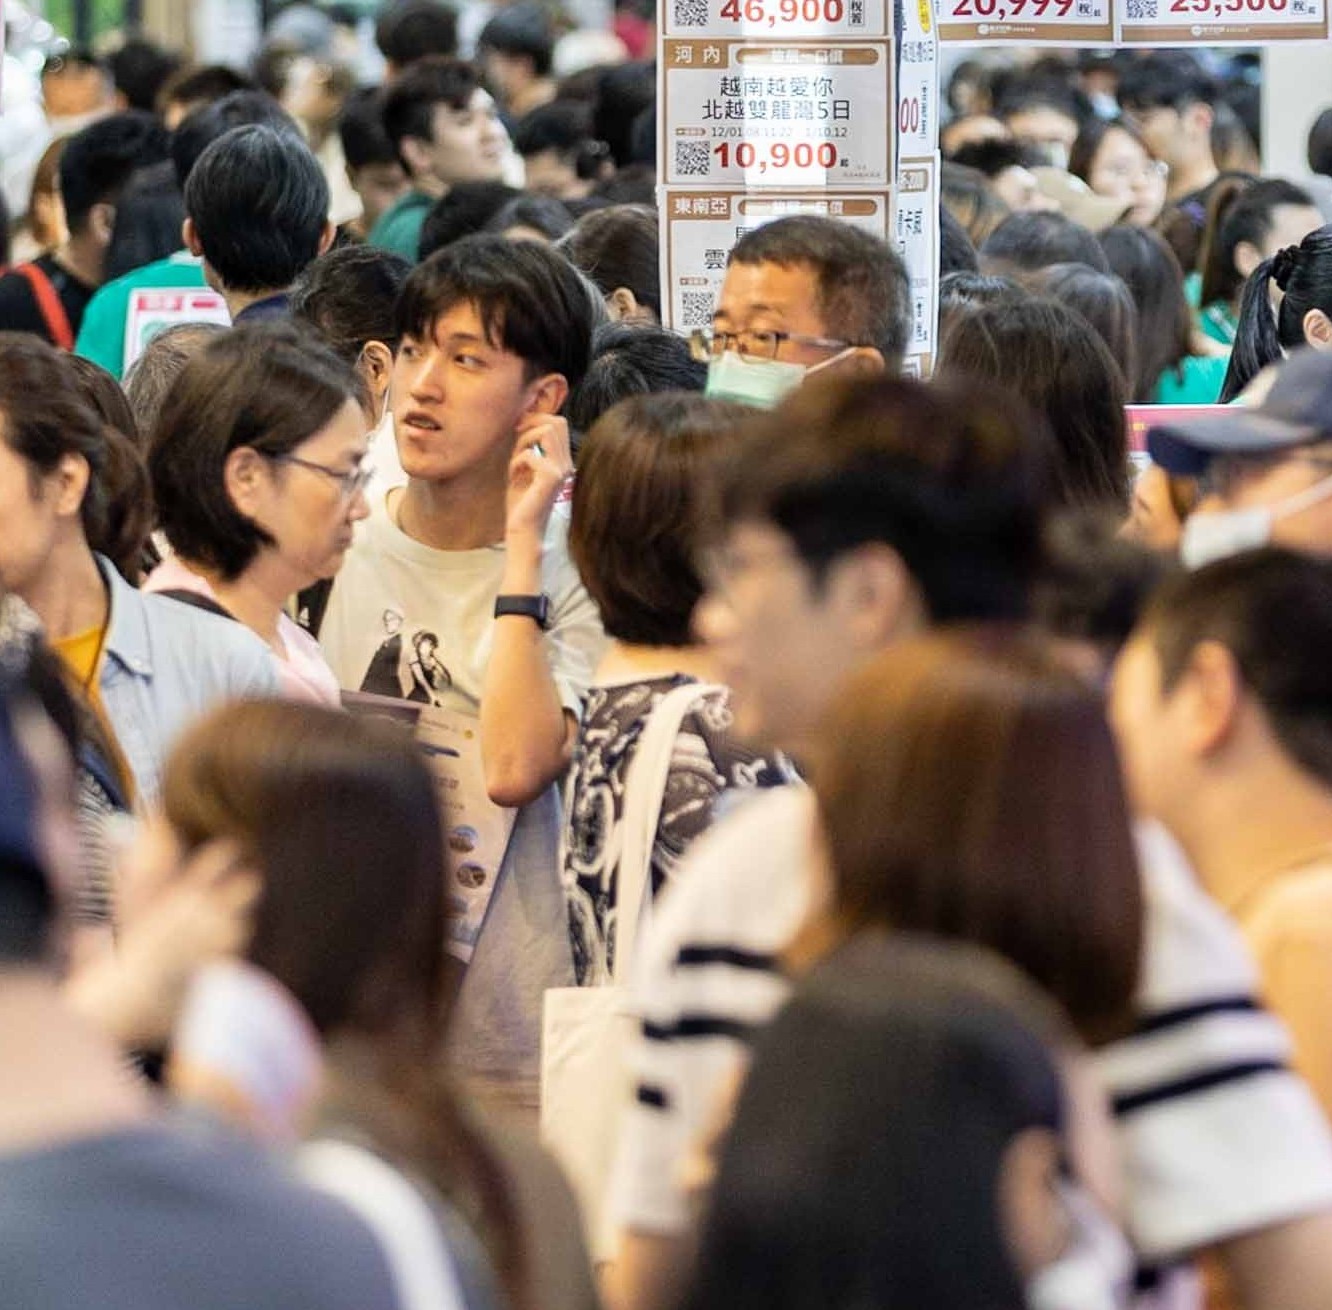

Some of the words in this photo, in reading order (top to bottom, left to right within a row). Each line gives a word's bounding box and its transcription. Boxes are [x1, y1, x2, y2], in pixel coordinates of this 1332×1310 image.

[720, 0, 843, 27] 46,900
[952, 0, 1073, 20] 20,999
[674, 46, 721, 64] 河內
[720, 76, 833, 97] 越南越愛你
[702, 99, 850, 121] 北越雙龍灣5日
[713, 141, 838, 174] 10,900
[674, 197, 728, 215] 東南亞
